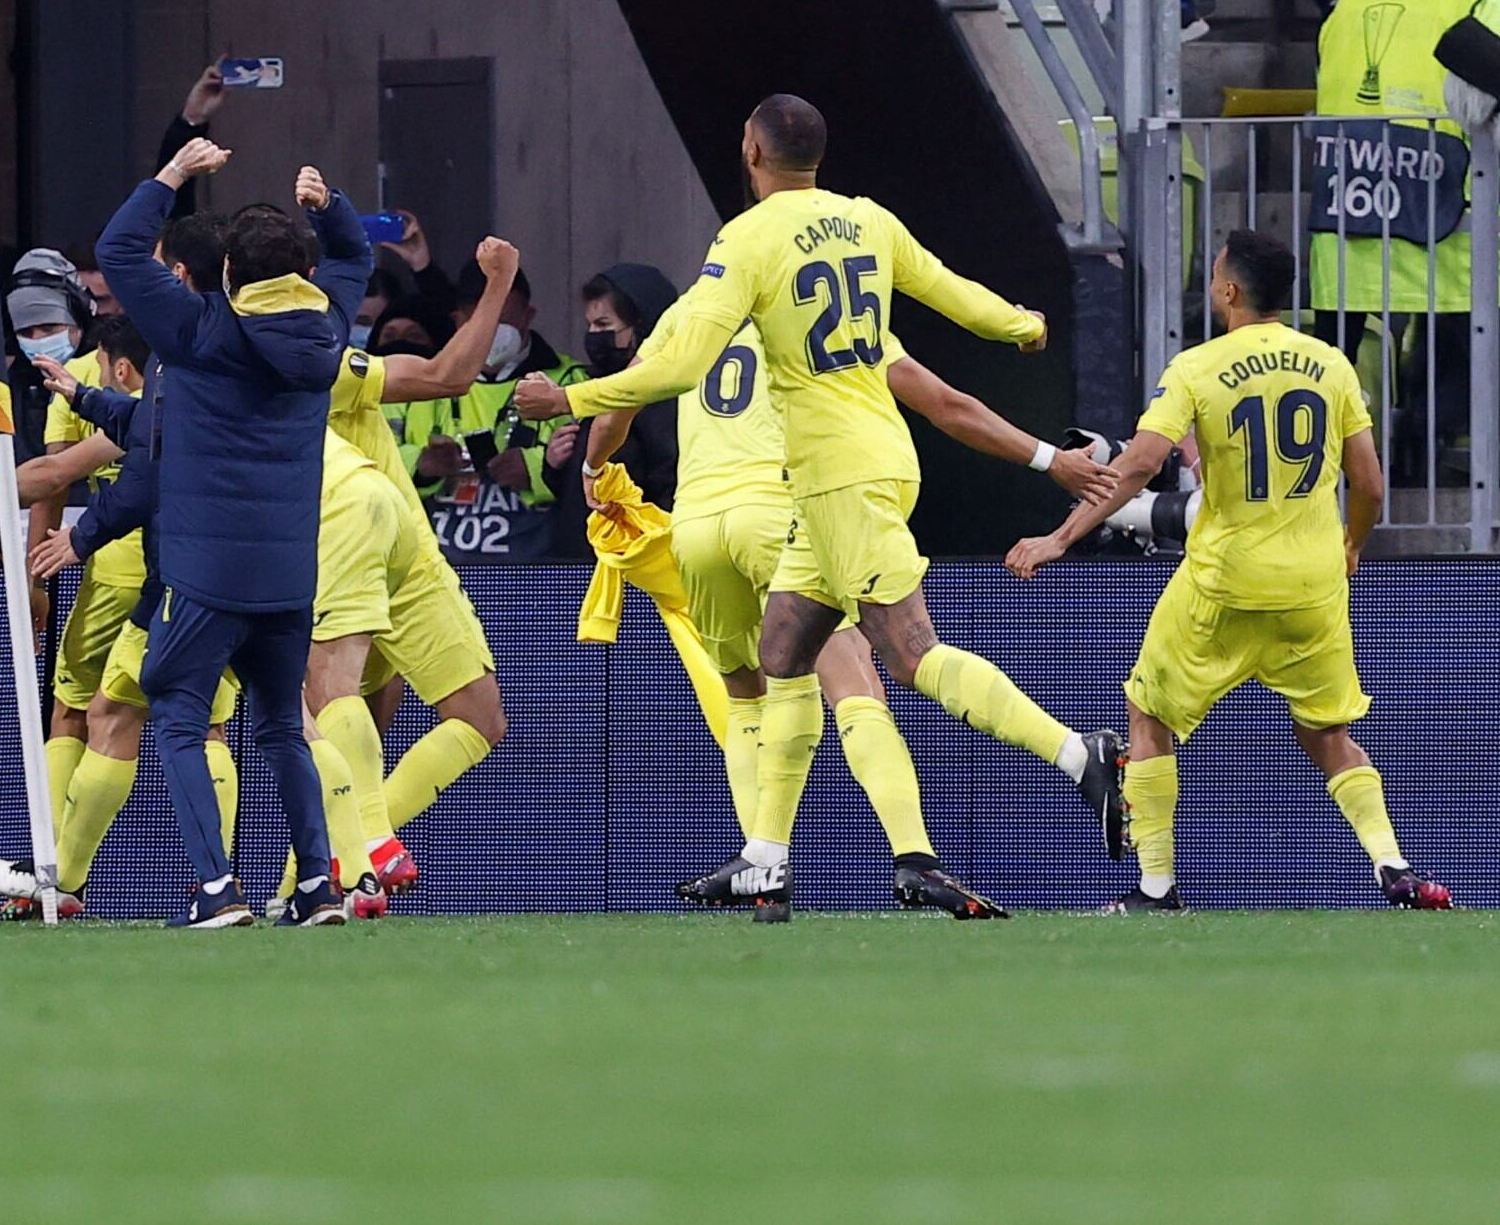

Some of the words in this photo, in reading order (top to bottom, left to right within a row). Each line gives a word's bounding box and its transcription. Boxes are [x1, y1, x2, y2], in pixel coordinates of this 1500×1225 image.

[1326, 174, 1402, 220] 160
[794, 216, 862, 255] CAPOUE
[792, 255, 884, 376] 25
[1218, 350, 1326, 389] COQUELIN
[1226, 389, 1327, 502] 19
[432, 510, 510, 553] 102
[731, 860, 788, 896] NIKE
